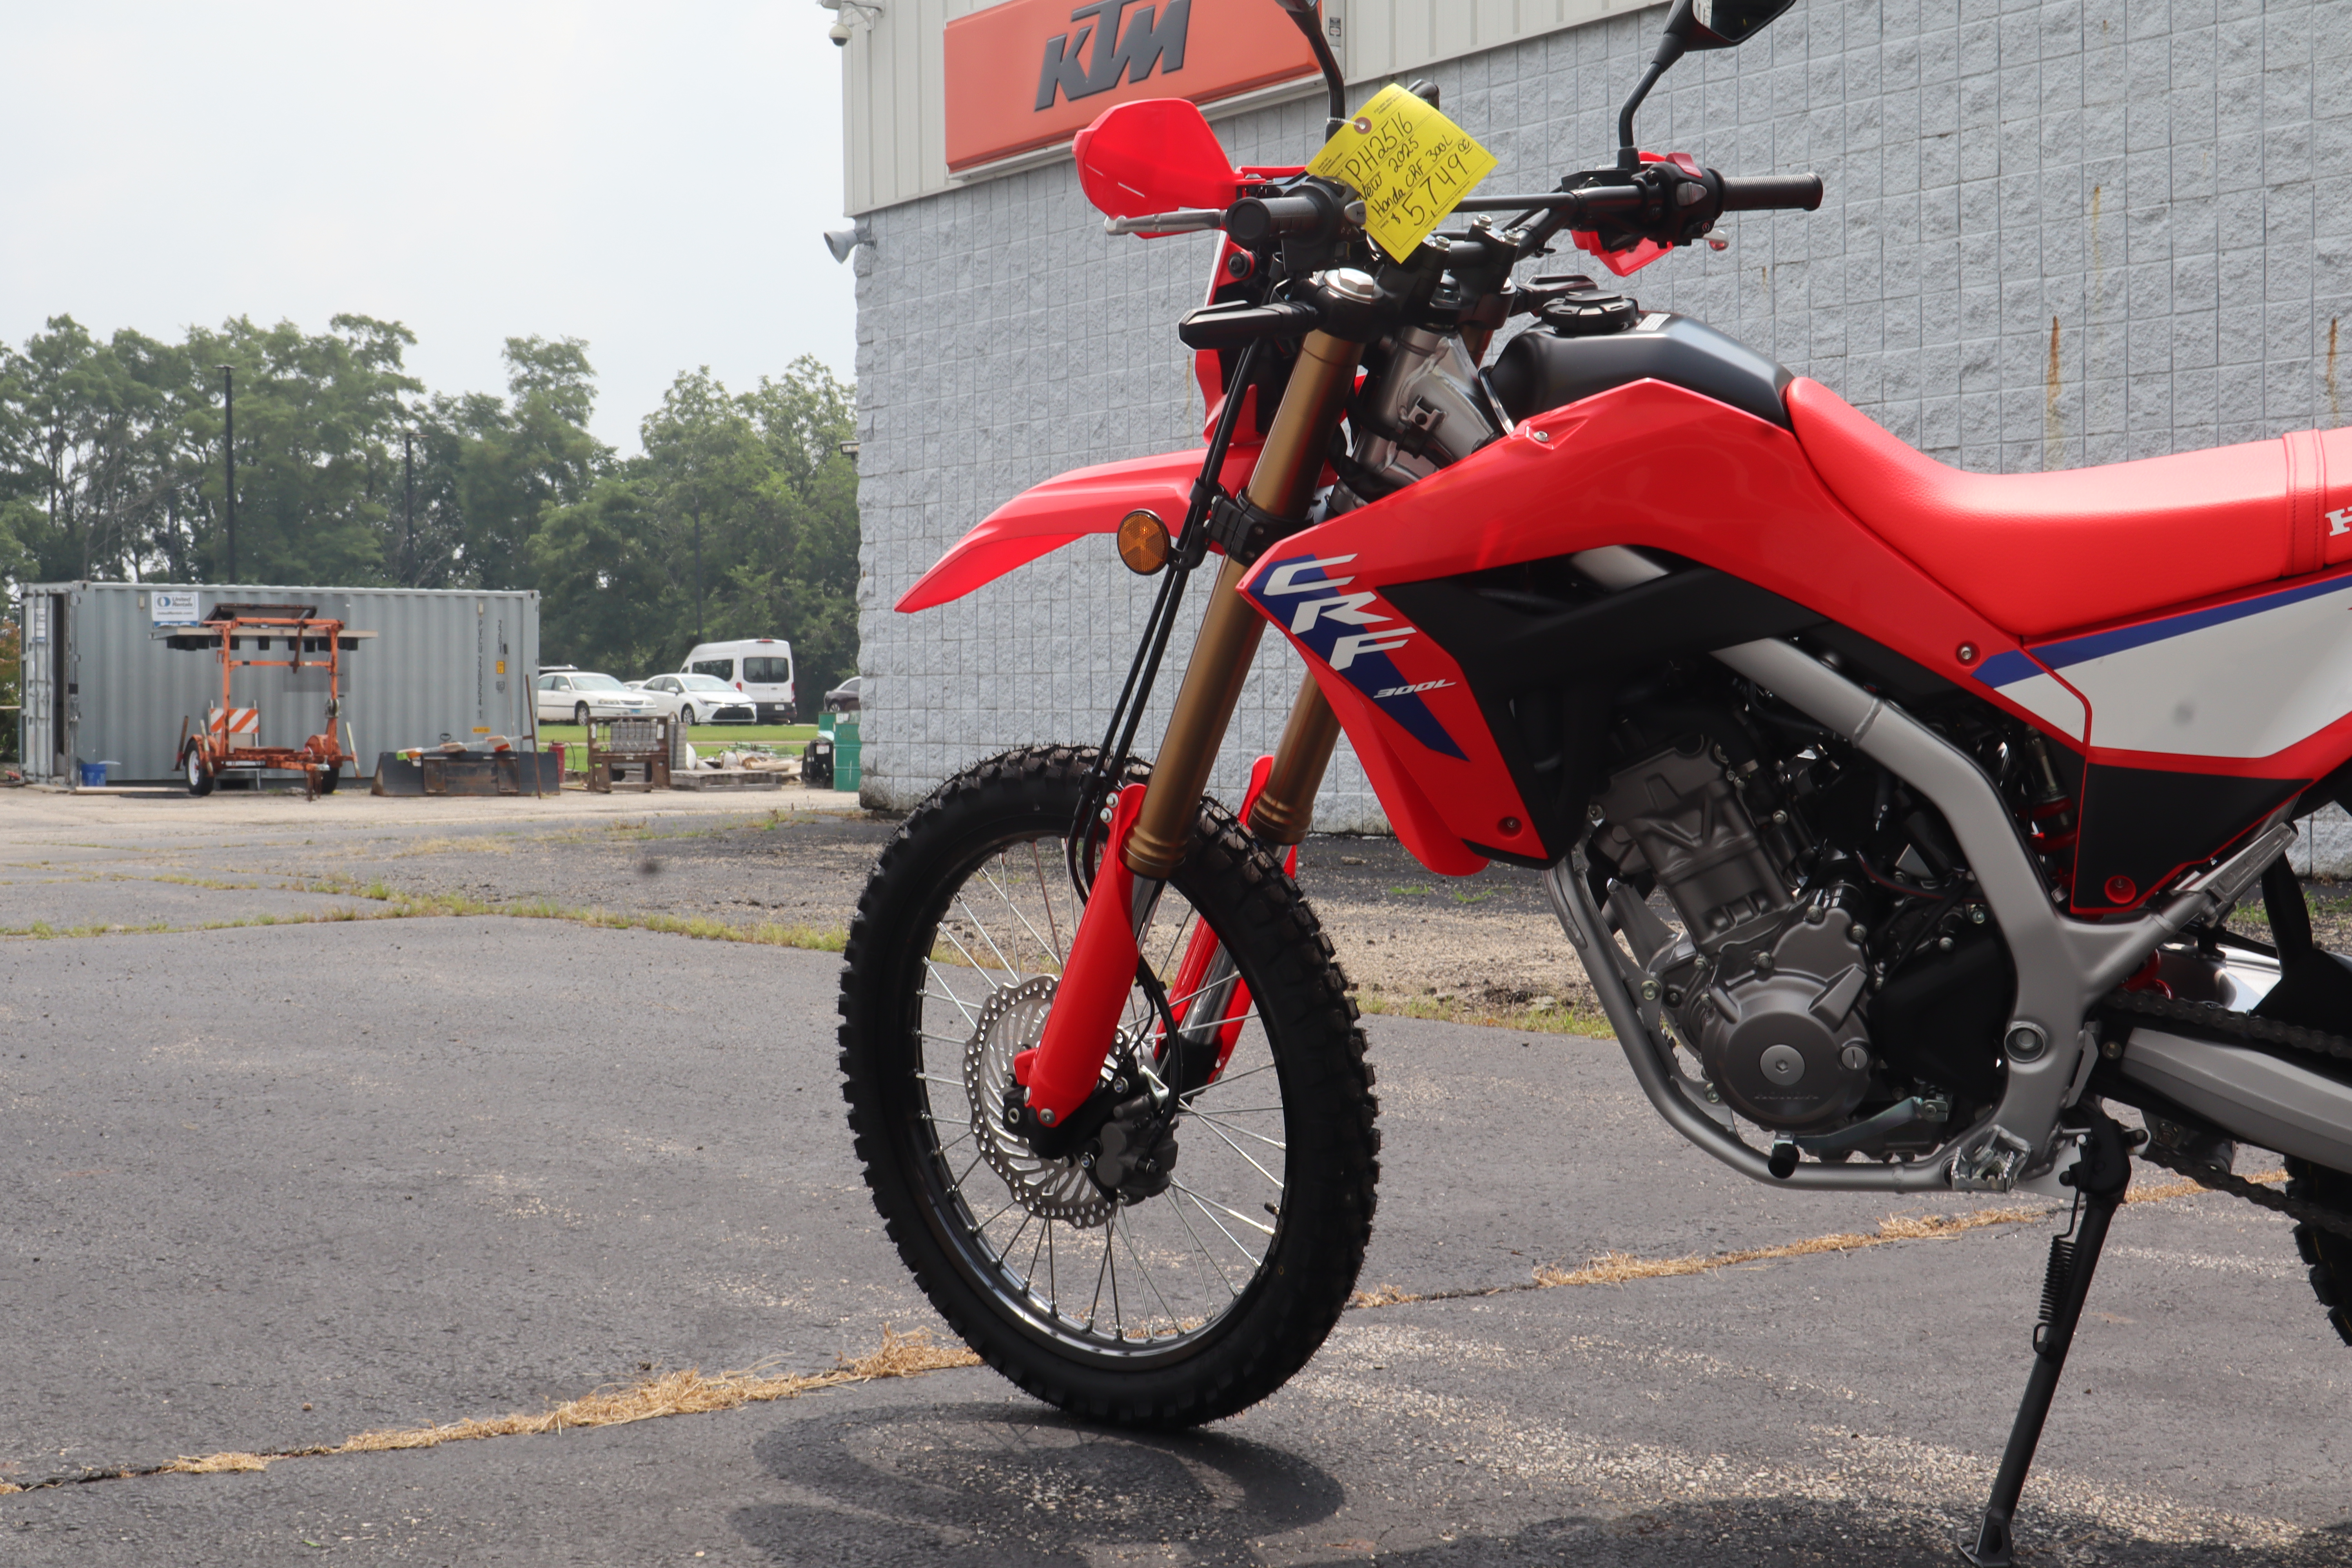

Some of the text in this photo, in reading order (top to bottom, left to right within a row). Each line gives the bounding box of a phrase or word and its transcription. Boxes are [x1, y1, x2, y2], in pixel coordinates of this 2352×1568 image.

[1034, 0, 1192, 112] KTM
[1345, 111, 1412, 183] PH2516
[1358, 173, 1382, 201] New
[1388, 133, 1419, 173] 2025
[1371, 186, 1406, 218] Honda
[1406, 158, 1423, 187] CRF
[1426, 134, 1453, 162] 300L
[1263, 553, 1417, 671] CRF
[1374, 679, 1456, 699] 300L
